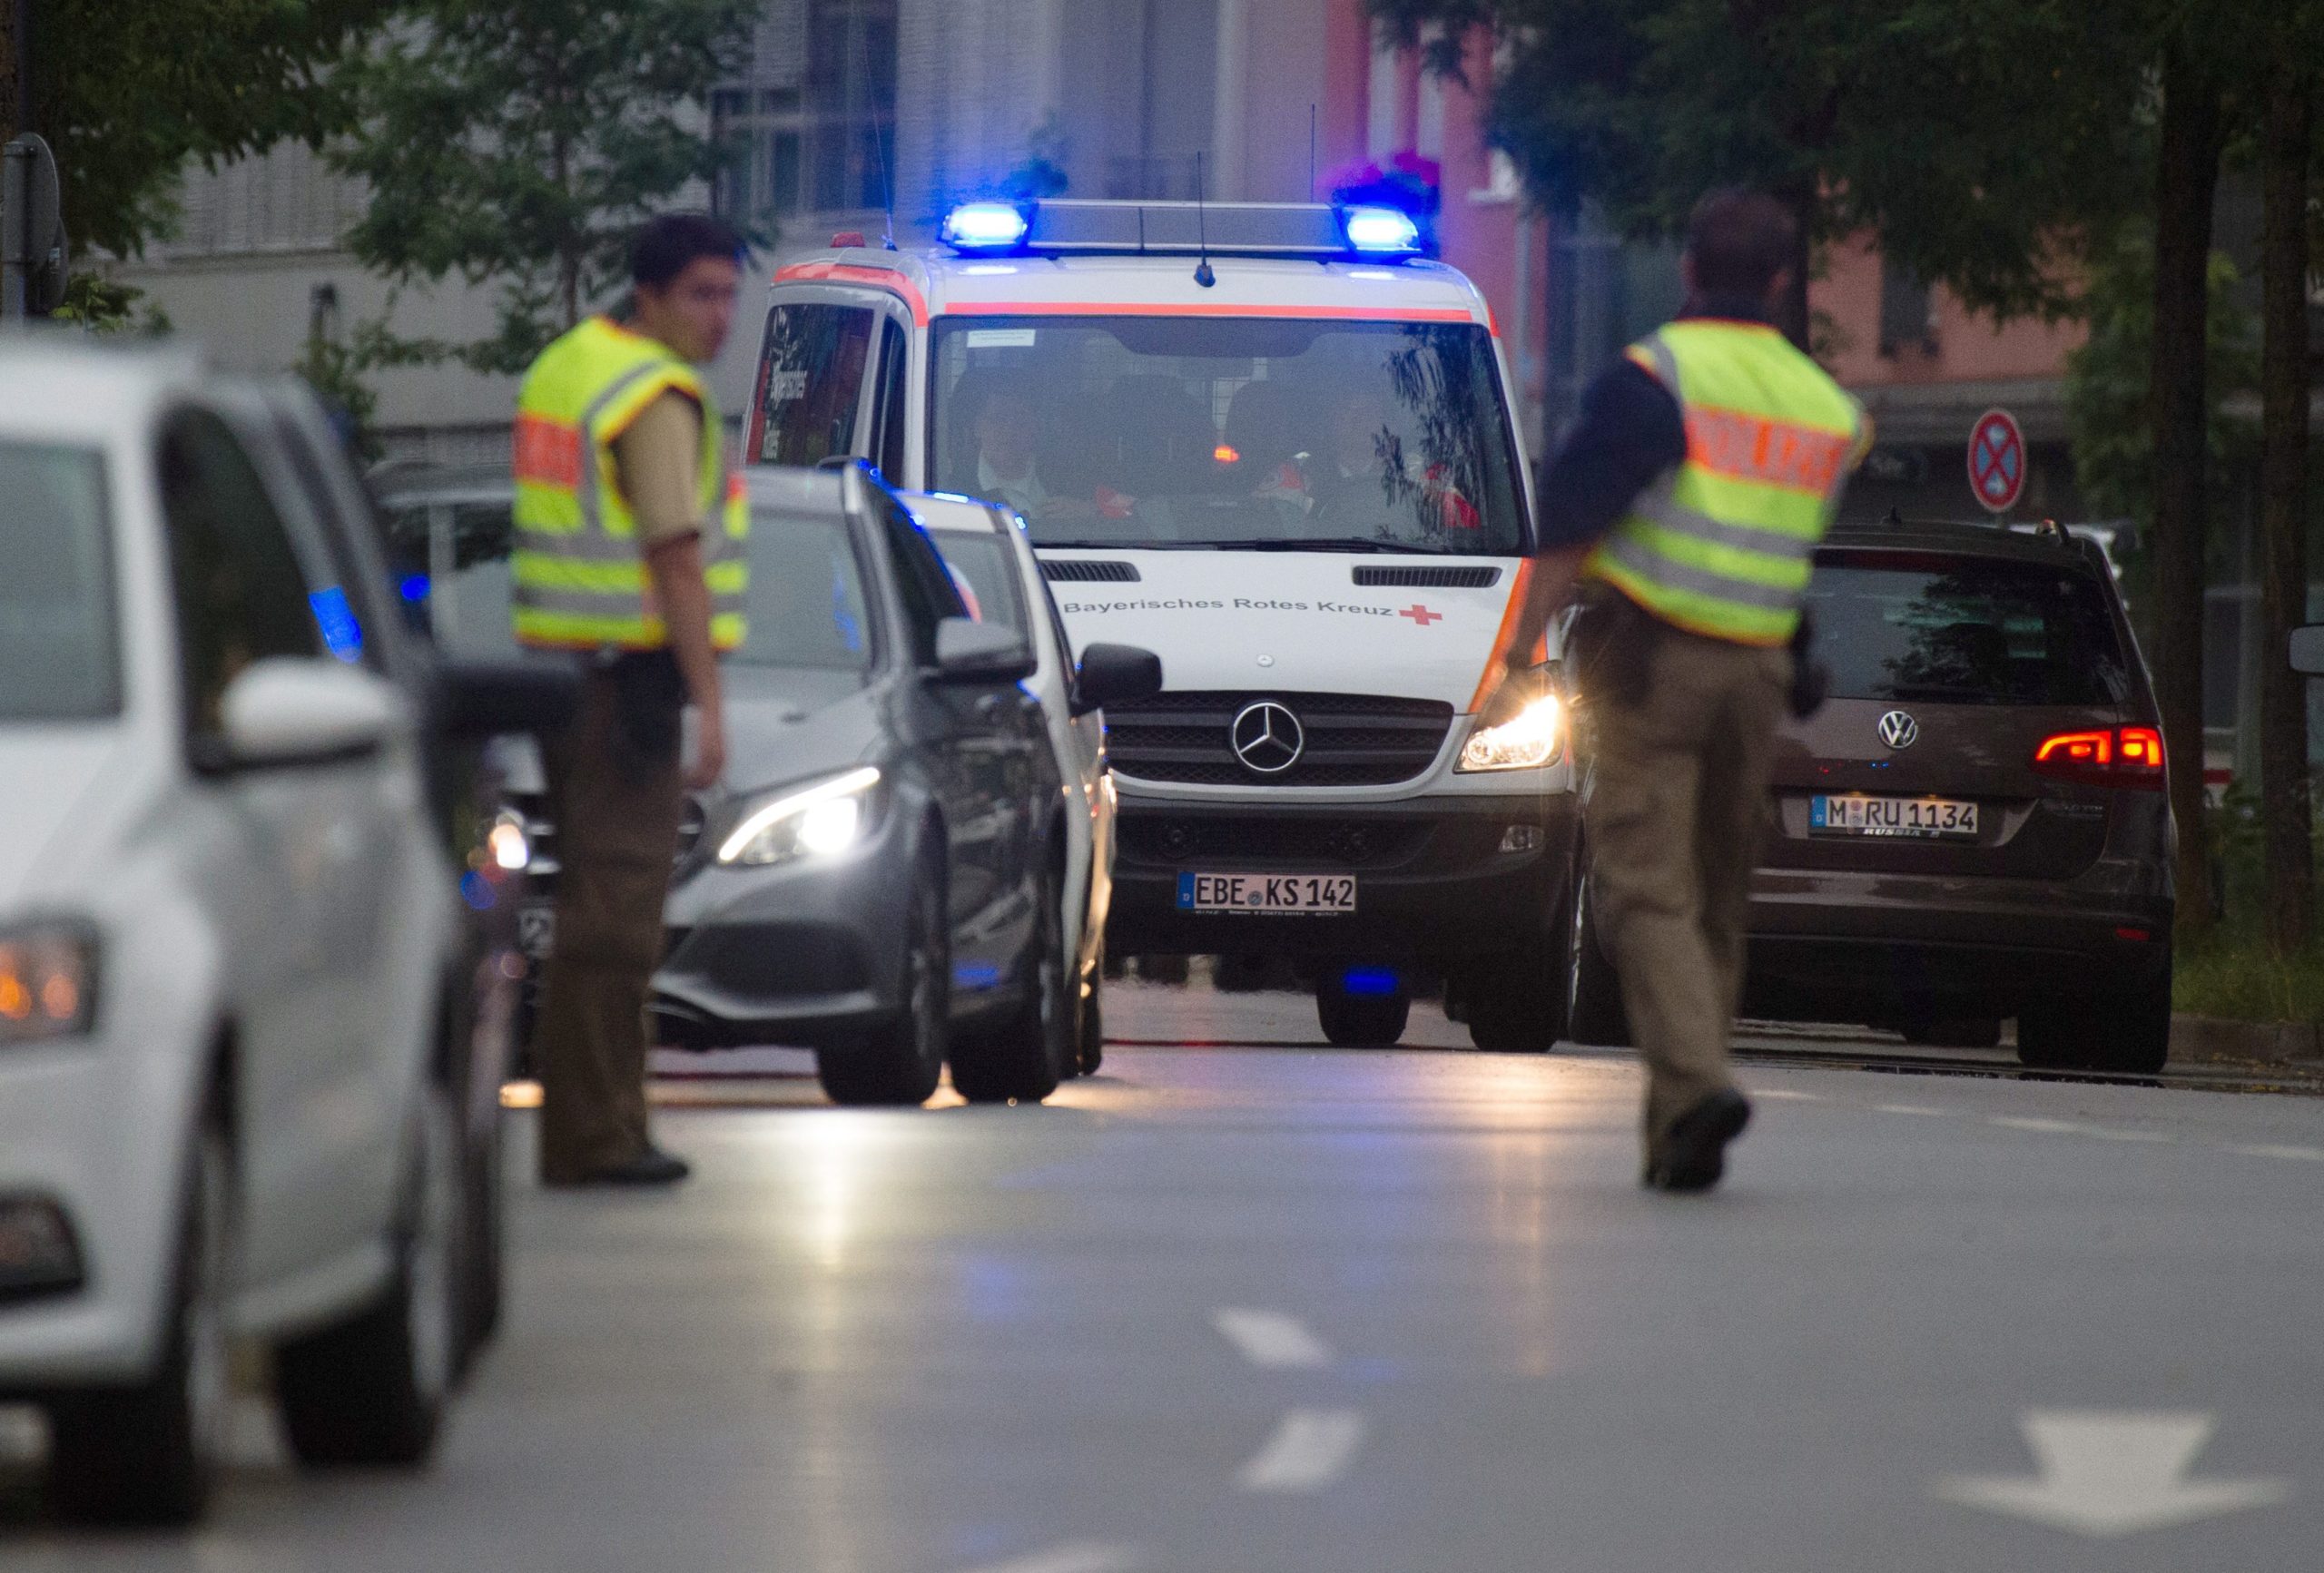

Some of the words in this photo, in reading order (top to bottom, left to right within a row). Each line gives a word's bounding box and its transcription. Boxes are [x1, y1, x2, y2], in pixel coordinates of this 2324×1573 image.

[1063, 597, 1224, 614] Bayerisches
[1233, 598, 1309, 611] Rotes
[1316, 601, 1393, 616] Kreuz
[1829, 800, 1846, 824] M
[1866, 801, 1901, 826] RU
[1907, 802, 1974, 831] 1134
[1196, 876, 1246, 905] EBE
[1265, 878, 1299, 907] KS
[1305, 879, 1354, 907] 142
